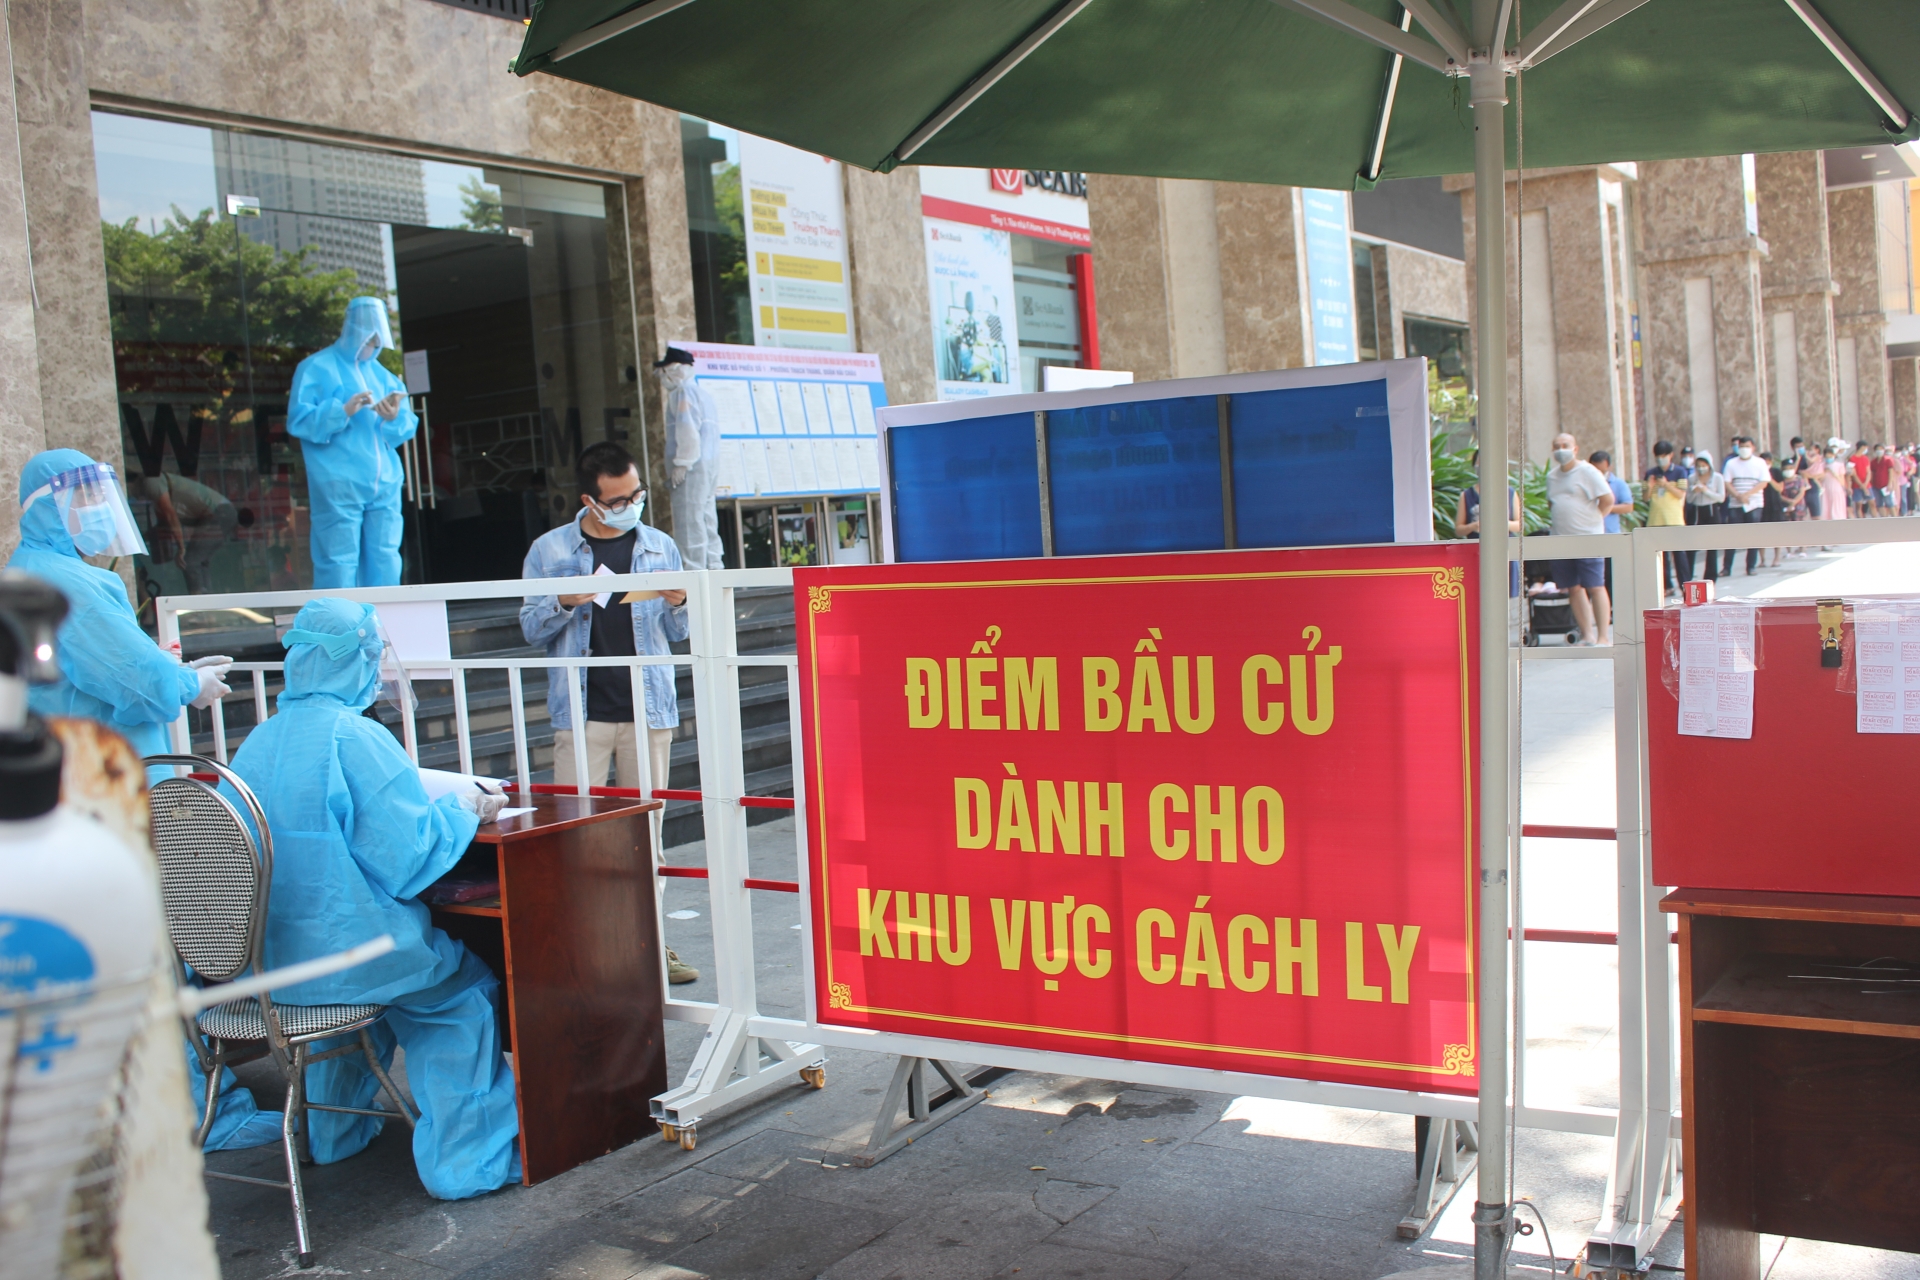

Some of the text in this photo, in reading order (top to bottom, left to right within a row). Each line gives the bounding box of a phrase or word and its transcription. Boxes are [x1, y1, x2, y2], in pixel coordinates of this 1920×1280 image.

[905, 625, 1342, 736] ĐIỂM BẦU CỬ
[954, 763, 1285, 866] DÀNH CHO
[857, 888, 1421, 1005] KHU VỰC CÁCH LY
